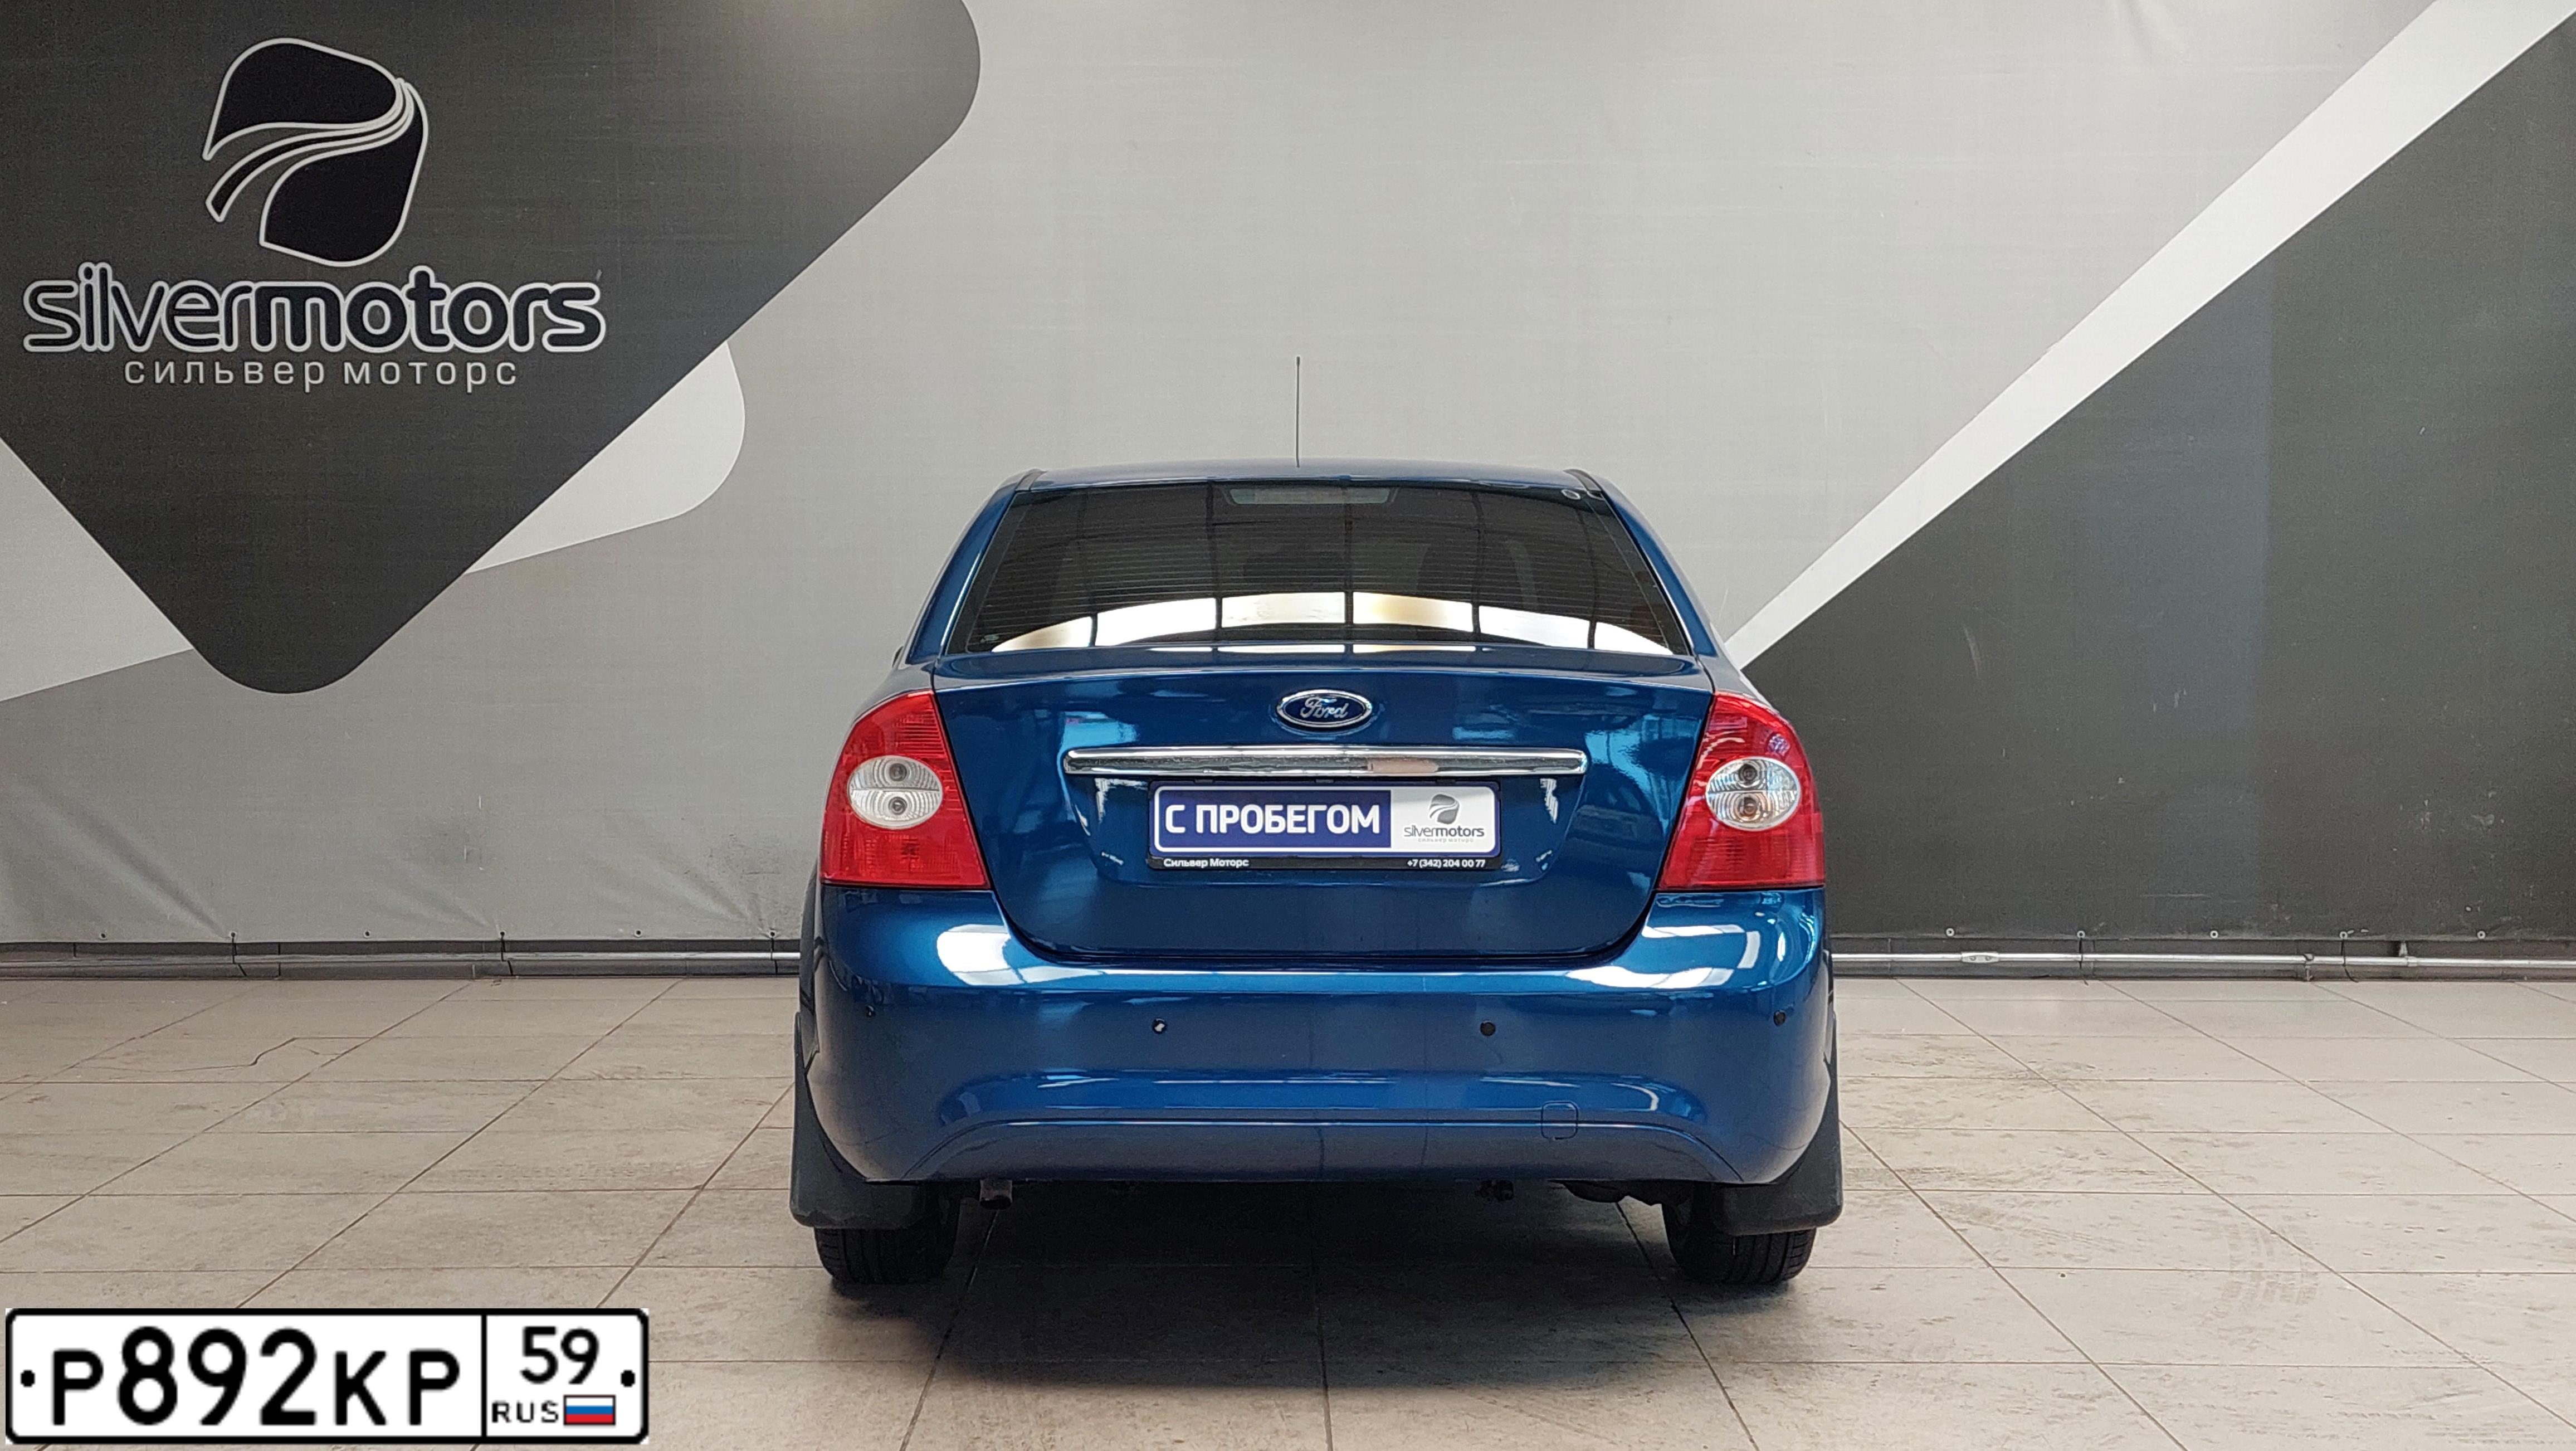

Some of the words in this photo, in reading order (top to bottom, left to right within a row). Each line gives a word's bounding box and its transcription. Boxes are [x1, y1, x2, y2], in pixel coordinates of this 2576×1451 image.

[23, 262, 606, 352] silvermotors
[124, 360, 325, 392] сильвер
[343, 361, 517, 392] моторс
[1300, 697, 1349, 718] Ford
[1165, 805, 1185, 833] С
[1196, 804, 1379, 834] ПРОБЕГОМ
[1403, 825, 1485, 837] silvermotors
[1164, 858, 1208, 868] Сильвер
[1209, 858, 1249, 868] Моторс
[1419, 859, 1441, 868] (342)
